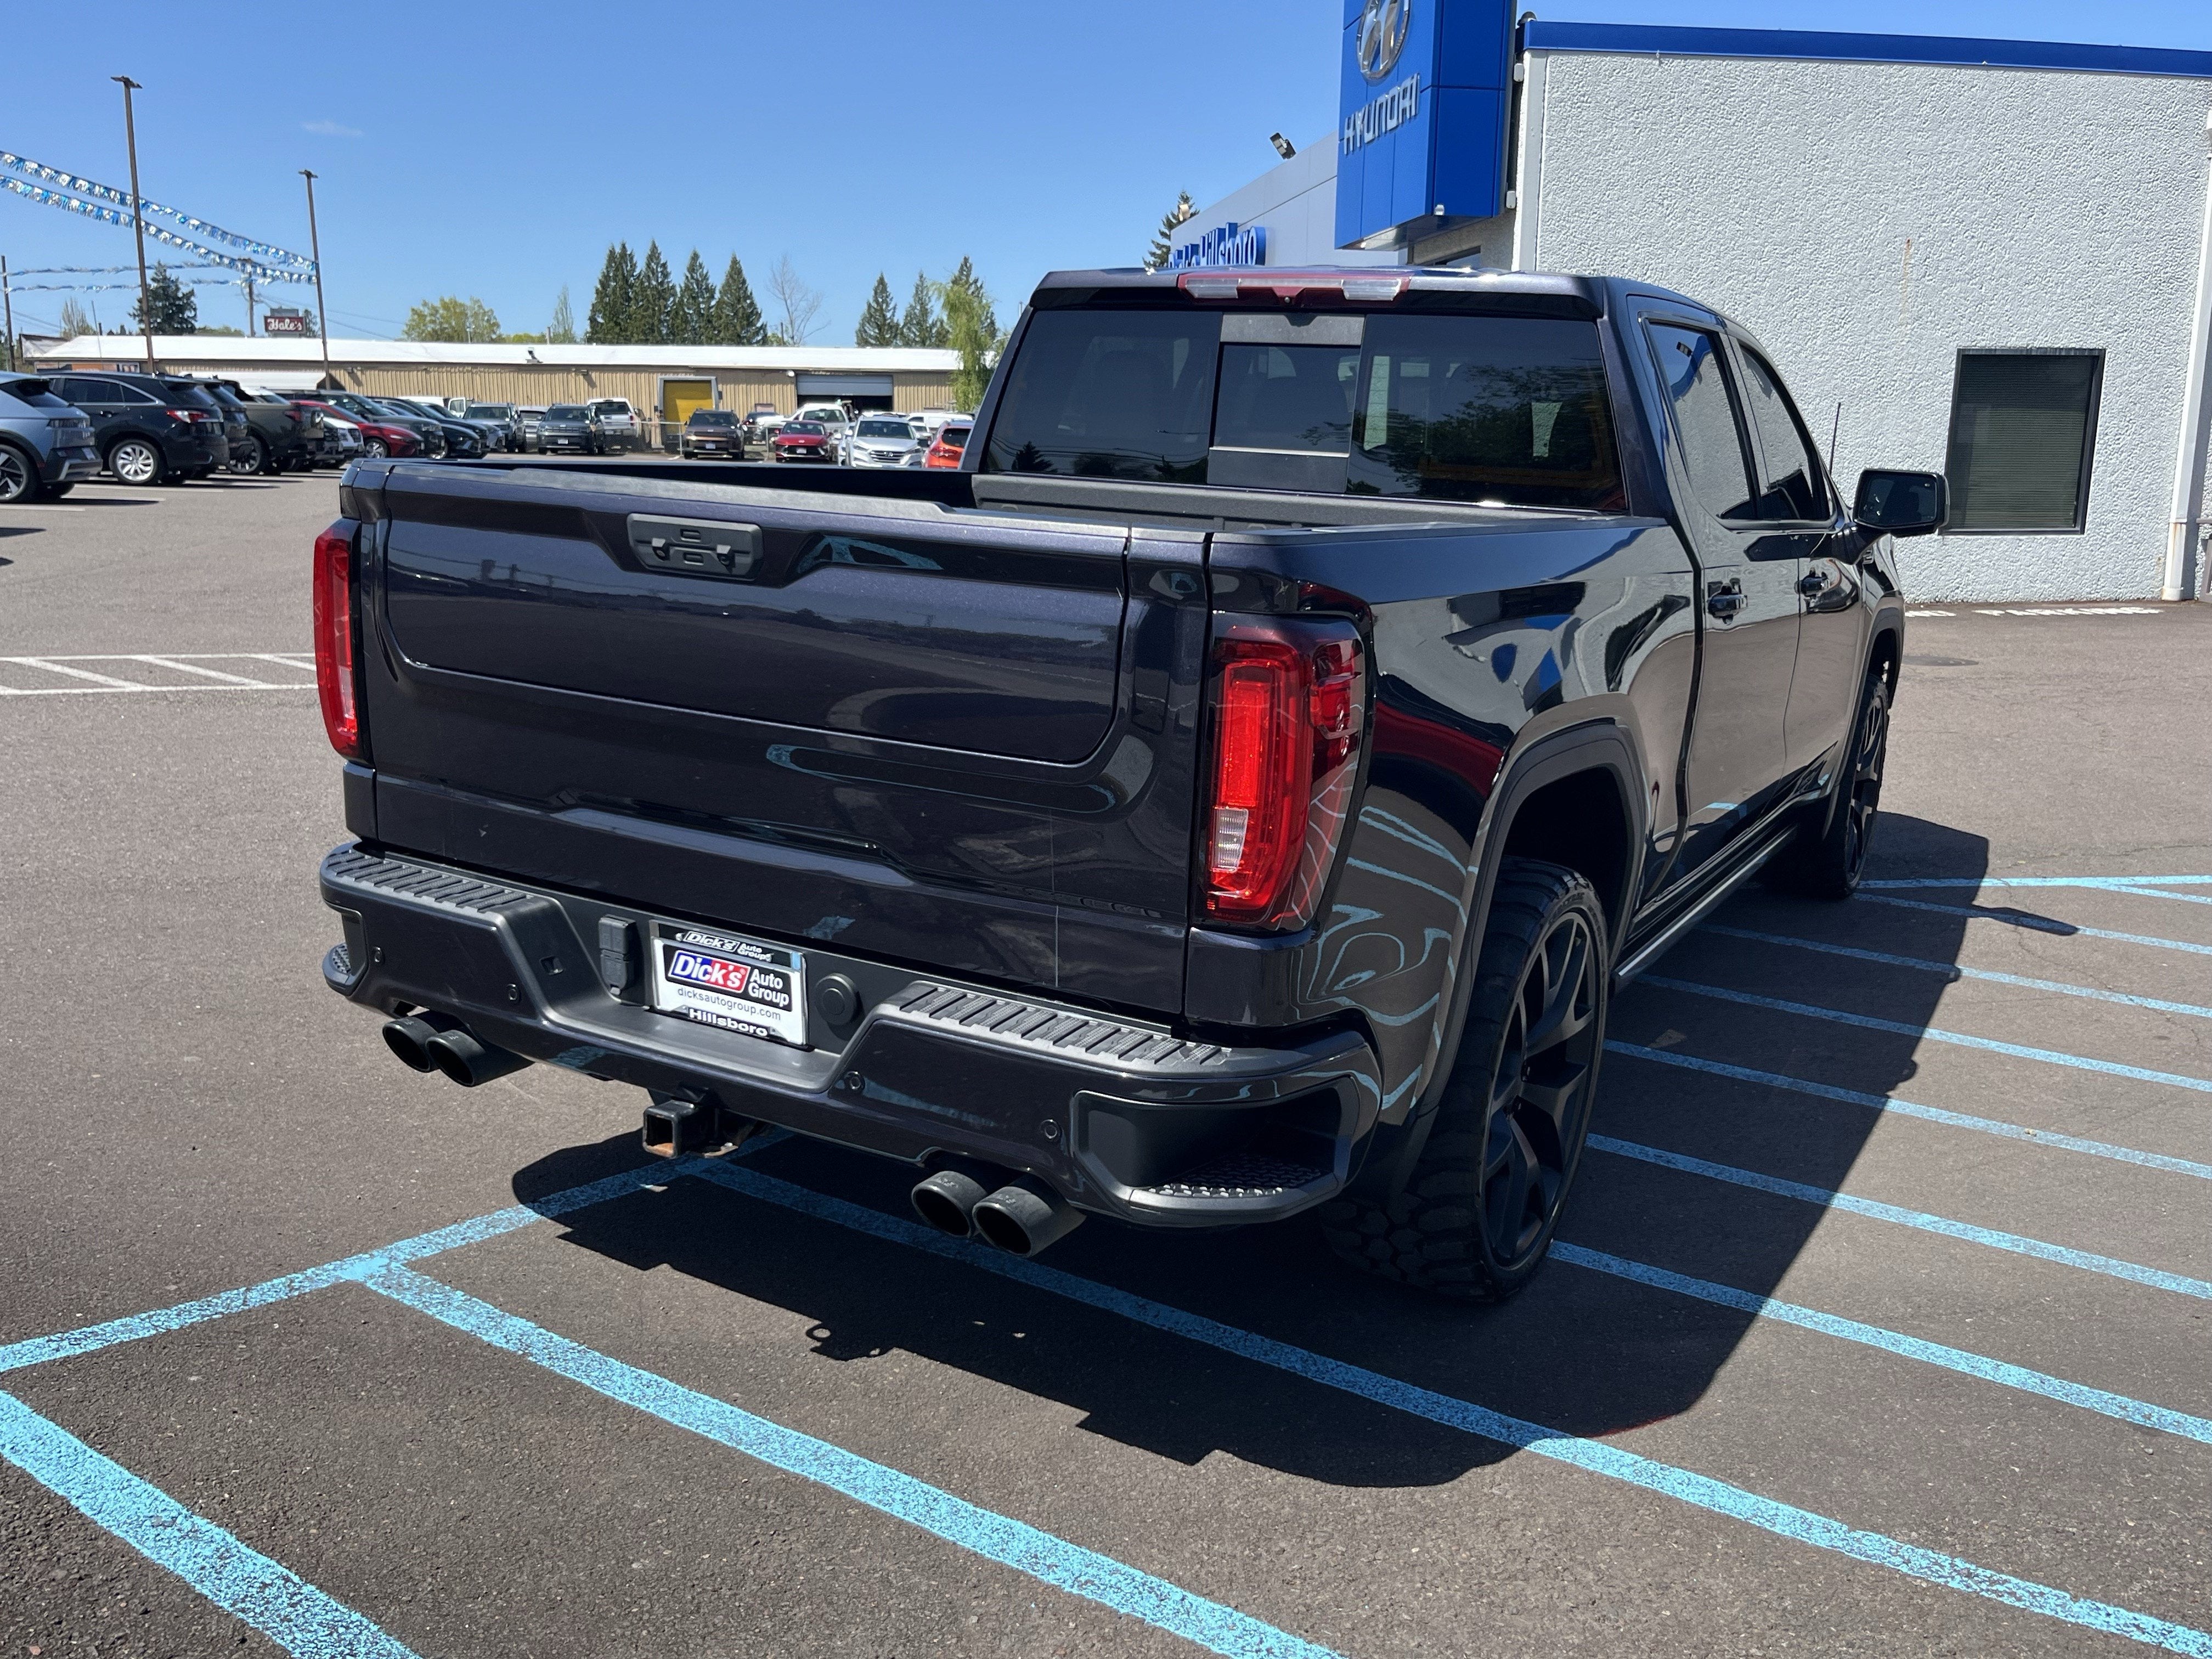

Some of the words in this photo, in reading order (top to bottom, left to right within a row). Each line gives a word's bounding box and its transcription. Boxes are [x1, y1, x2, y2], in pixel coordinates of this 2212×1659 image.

[1344, 72, 1420, 155] HYUNDAI
[267, 318, 302, 331] Hale's
[686, 932, 736, 950] Dick's
[740, 943, 763, 953] Auto
[737, 948, 766, 961] Group
[673, 954, 743, 988] Dick's
[750, 969, 783, 989] Auto
[678, 987, 781, 1021] dicksautogroup.com
[748, 982, 789, 1007] Group
[689, 1008, 768, 1037] Hillsboro
